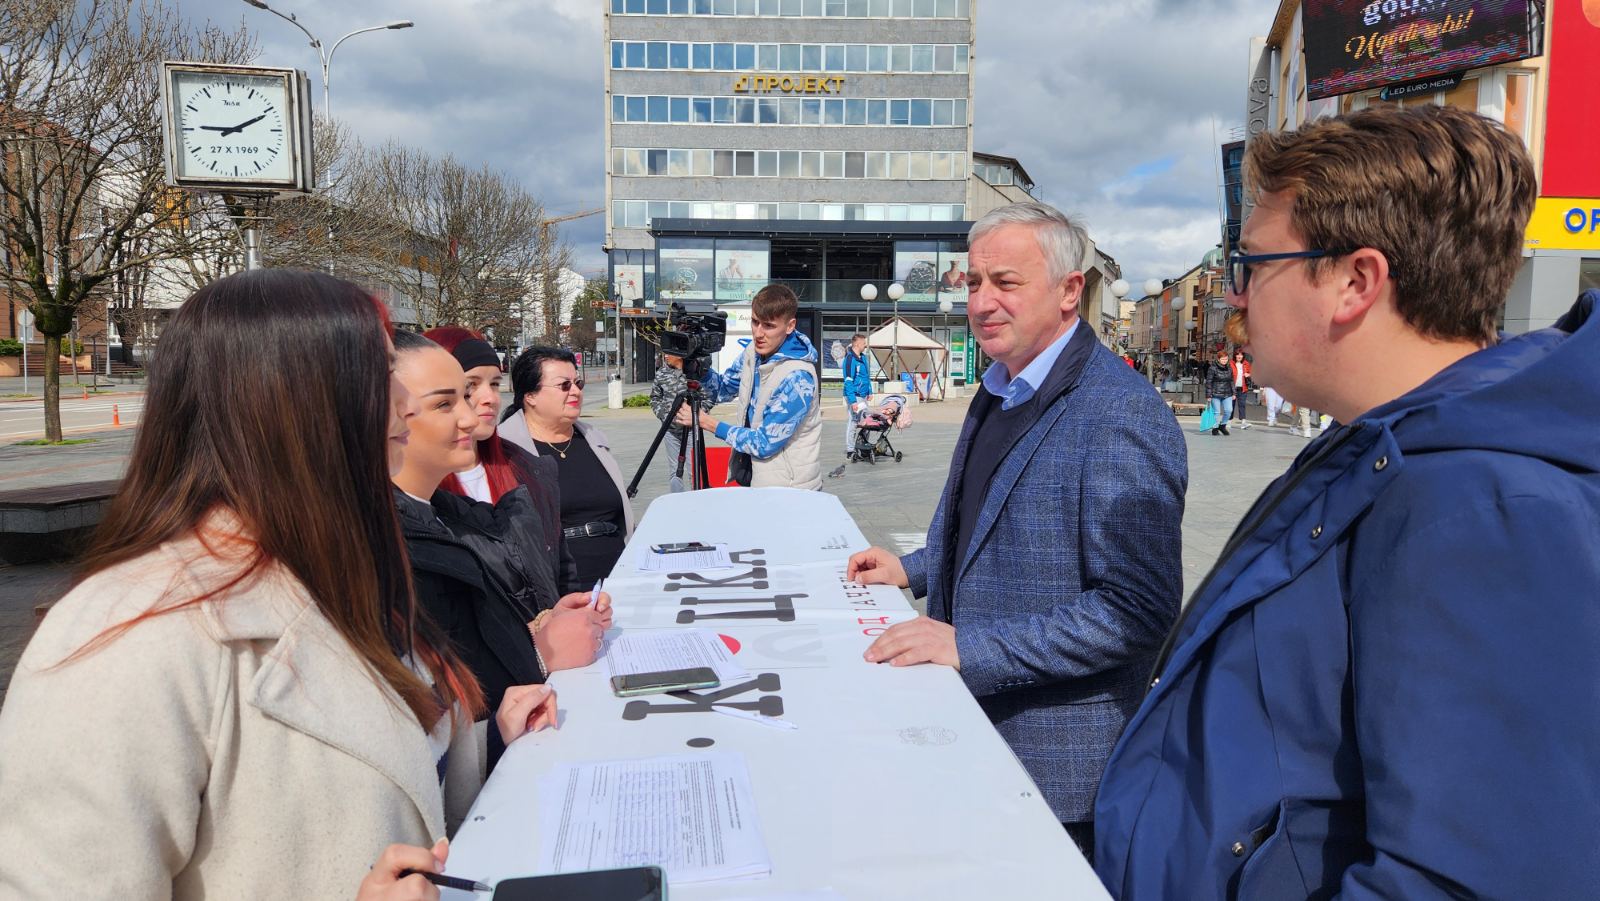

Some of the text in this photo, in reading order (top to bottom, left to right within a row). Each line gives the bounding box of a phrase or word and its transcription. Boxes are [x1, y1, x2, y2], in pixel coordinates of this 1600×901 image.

[754, 75, 844, 93] ПРОЈЕКТ
[1389, 78, 1455, 96] LED EURO MEDIA
[1249, 78, 1269, 135] ova
[210, 146, 222, 154] 27
[236, 146, 259, 154] 1969
